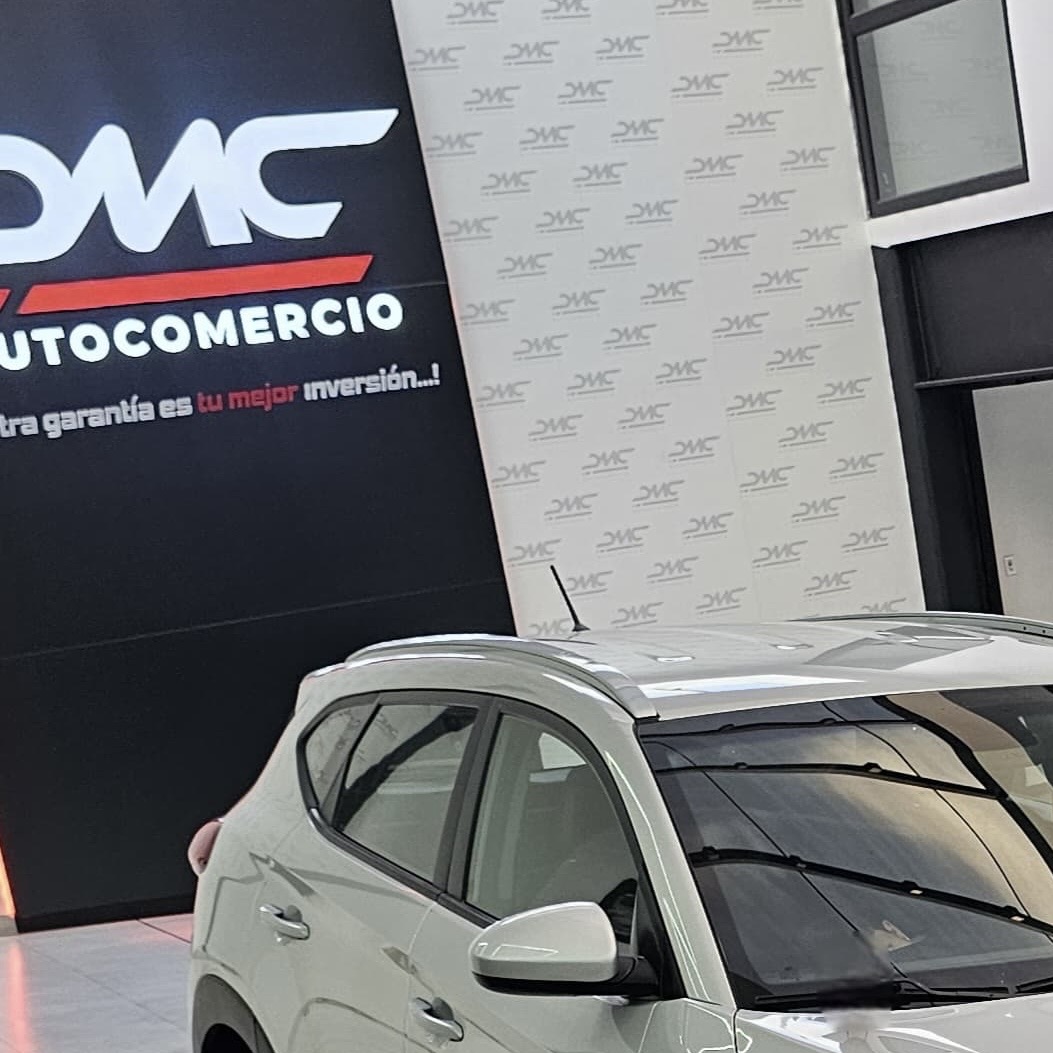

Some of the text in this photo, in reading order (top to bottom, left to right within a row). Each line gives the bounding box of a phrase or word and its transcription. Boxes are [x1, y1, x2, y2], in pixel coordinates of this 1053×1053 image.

[447, 0, 504, 18] DMC
[595, 36, 649, 54] DMC
[712, 29, 770, 47] DMC
[407, 46, 465, 65] DMC
[504, 41, 559, 60] DMC
[671, 74, 730, 92] DMC
[767, 67, 823, 85] DMC
[464, 86, 520, 105] DMC
[558, 80, 613, 98] DMC
[611, 119, 664, 137] DMC
[726, 110, 784, 129] DMC
[425, 132, 482, 151] DMC
[520, 125, 574, 144] DMC
[685, 154, 743, 174] DMC
[780, 147, 835, 165] DMC
[481, 170, 536, 190] DMC
[573, 162, 627, 182] DMC
[625, 200, 678, 219] DMC
[740, 190, 796, 209] DMC
[445, 217, 498, 236] DMC
[536, 208, 590, 228] DMC
[699, 234, 756, 254] DMC
[793, 225, 848, 244] DMC
[498, 253, 552, 274] DMC
[589, 244, 642, 264] DMC
[753, 268, 808, 288] DMC
[552, 290, 605, 310] DMC
[640, 280, 693, 300] DMC
[461, 299, 514, 320] DMC
[806, 301, 861, 322] DMC
[712, 312, 769, 333] DMC
[603, 324, 656, 344] DMC
[513, 334, 568, 356] DMC
[766, 345, 821, 366] DMC
[656, 358, 707, 379] DMC
[568, 370, 620, 390] DMC
[817, 378, 872, 398] DMC
[477, 381, 531, 402] DMC
[726, 390, 782, 411] DMC
[42, 394, 155, 439] garantía
[159, 396, 193, 418] es
[197, 391, 223, 413] tu
[228, 383, 299, 411] mejor
[618, 403, 670, 423] DMC
[528, 415, 583, 436] DMC
[778, 421, 833, 442] DMC
[668, 436, 720, 457] DMC
[582, 448, 635, 470] DMC
[829, 453, 884, 474] DMC
[492, 460, 546, 482] DMC
[740, 466, 795, 487] DMC
[632, 480, 685, 502] DMC
[544, 493, 597, 515] DMC
[792, 496, 846, 517] DMC
[682, 512, 734, 534] DMC
[596, 526, 649, 547] DMC
[842, 526, 895, 548] DMC
[507, 539, 561, 561] DMC
[752, 540, 808, 563] DMC
[647, 556, 698, 578] DMC
[804, 570, 857, 592] DMC
[696, 587, 746, 609] DMC
[611, 602, 664, 624] DMC
